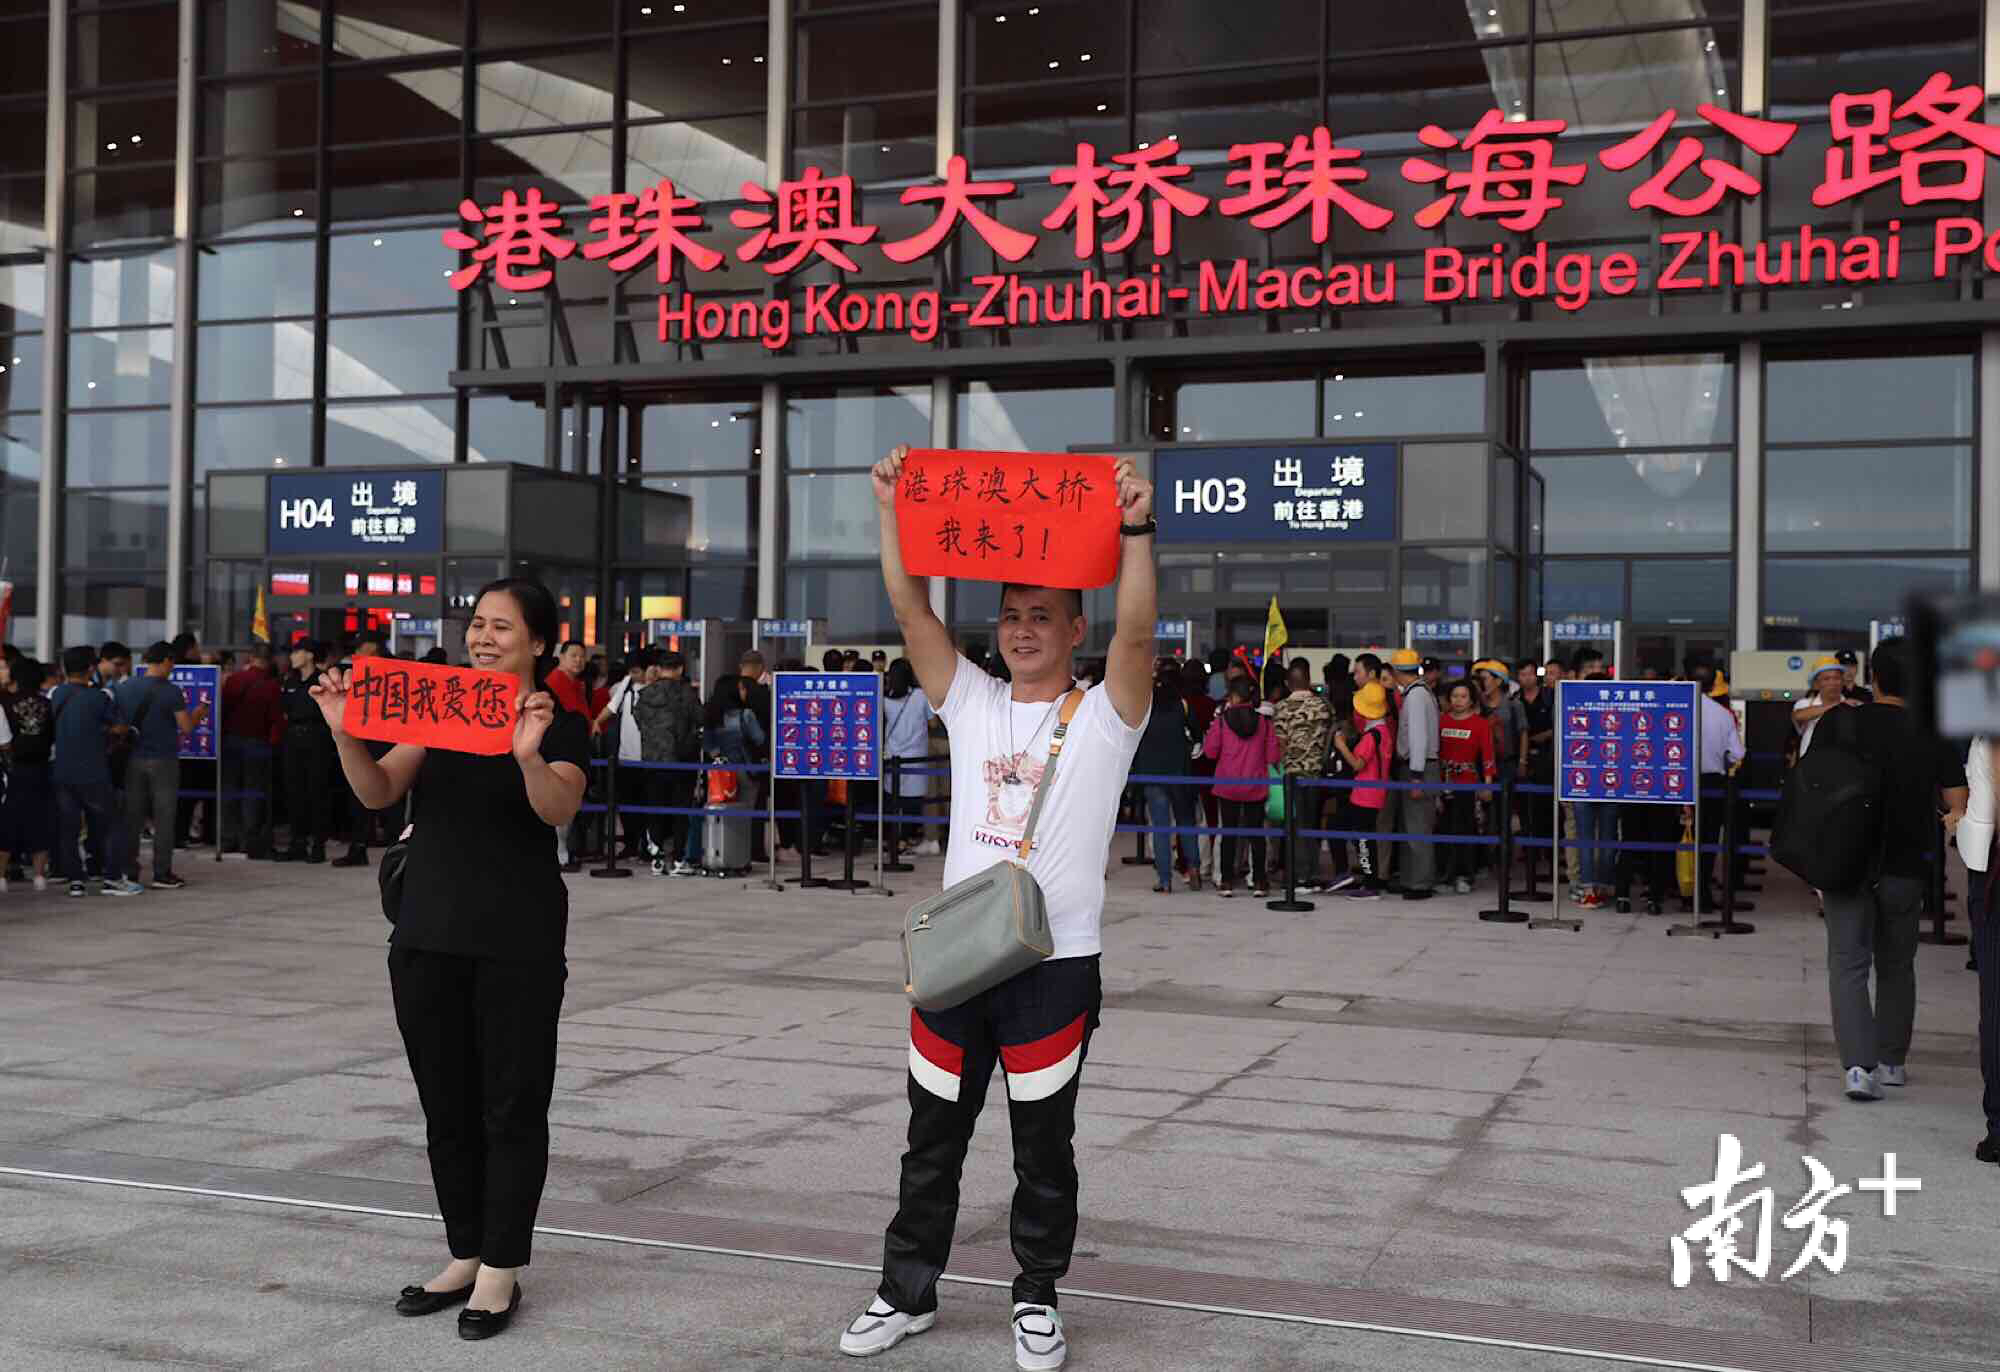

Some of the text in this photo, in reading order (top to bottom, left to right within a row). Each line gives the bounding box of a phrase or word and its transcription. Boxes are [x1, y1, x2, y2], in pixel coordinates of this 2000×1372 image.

[442, 72, 2000, 291] 港珠澳大桥珠海公路
[657, 293, 790, 349] Hong
[1424, 244, 1639, 311] Bridge
[1657, 219, 1901, 289] Zhuhai
[1273, 455, 1365, 487] 出境
[904, 466, 1095, 513] 港珠澳大桥
[1175, 477, 1247, 514] H03
[1295, 487, 1342, 498] Departure
[280, 498, 335, 529] H04
[351, 517, 416, 536] 前往香港
[1273, 498, 1364, 521] 前往香港
[353, 666, 510, 729] 中国我爱您
